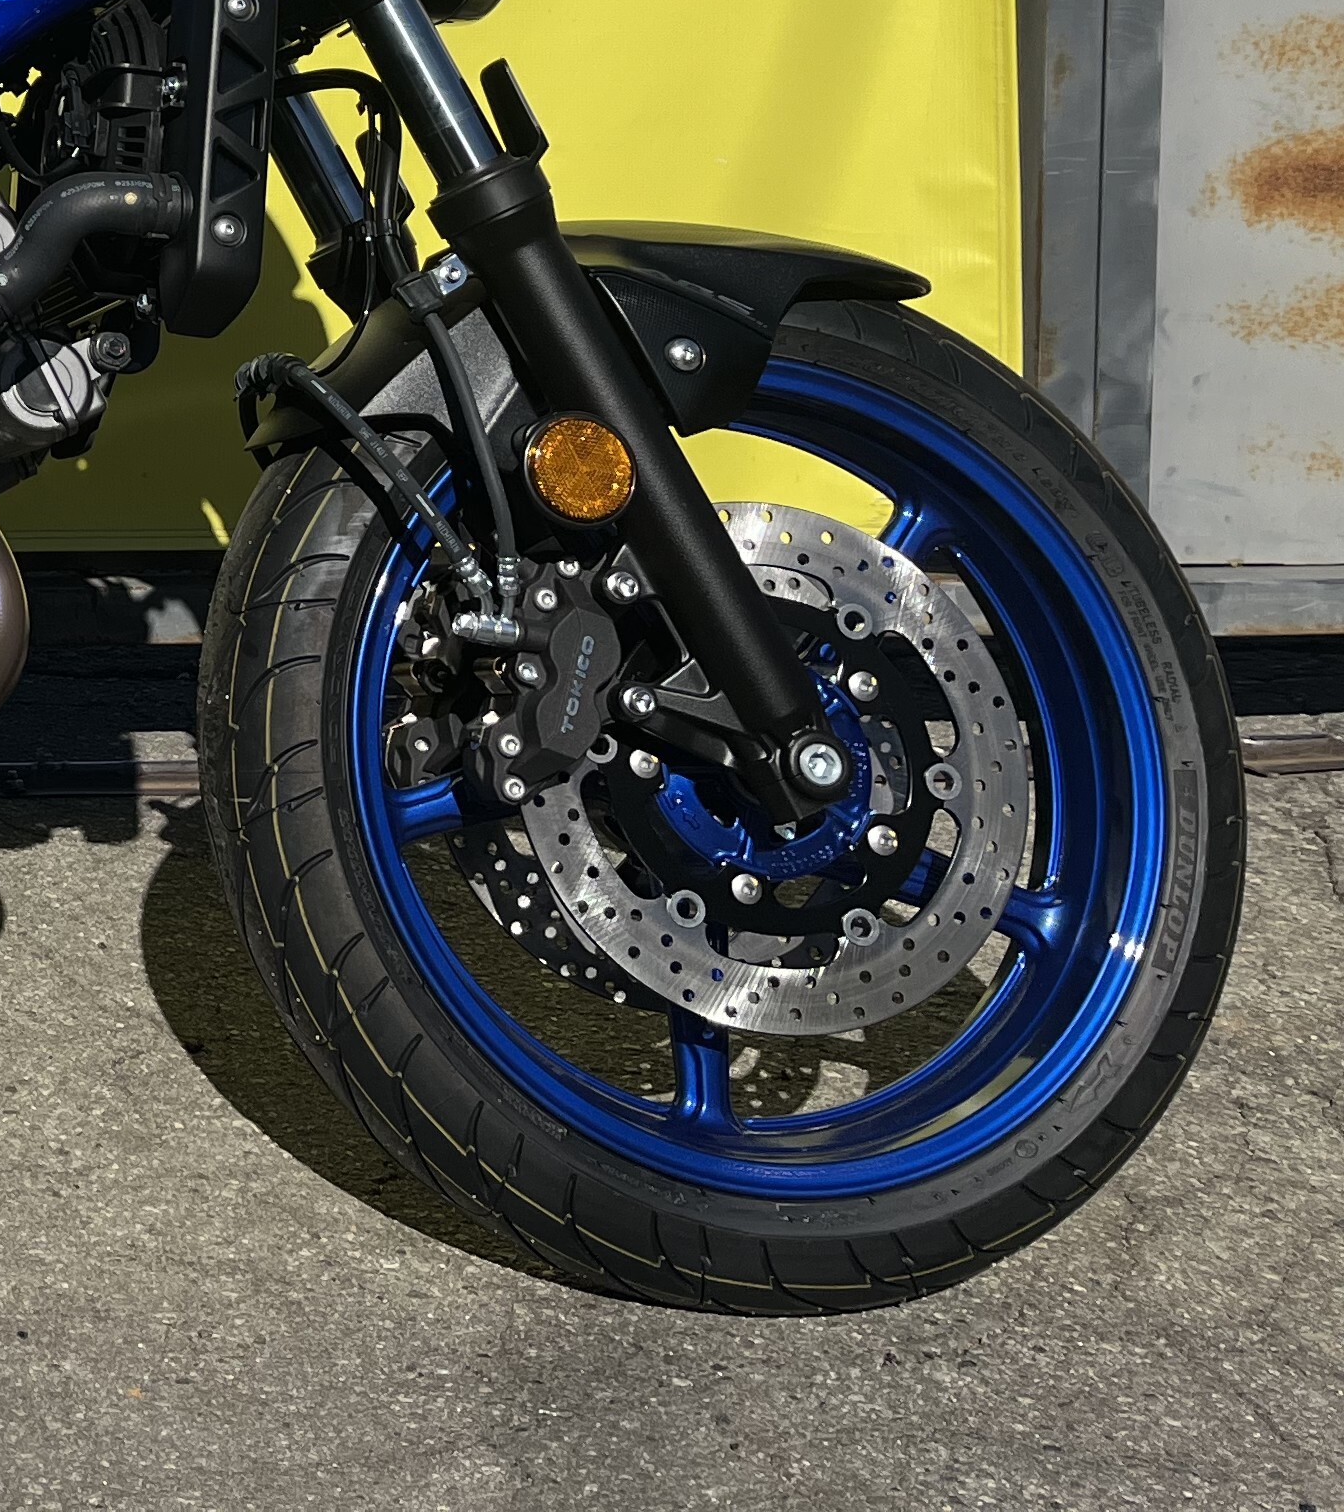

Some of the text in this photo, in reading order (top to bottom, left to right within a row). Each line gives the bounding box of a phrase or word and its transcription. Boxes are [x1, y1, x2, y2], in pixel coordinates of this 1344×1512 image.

[434, 520, 461, 554] NICHIRIN
[560, 635, 595, 734] TOKICO
[1129, 584, 1183, 705] TUBELESS RADIAL
[1165, 804, 1196, 962] DUNLOP
